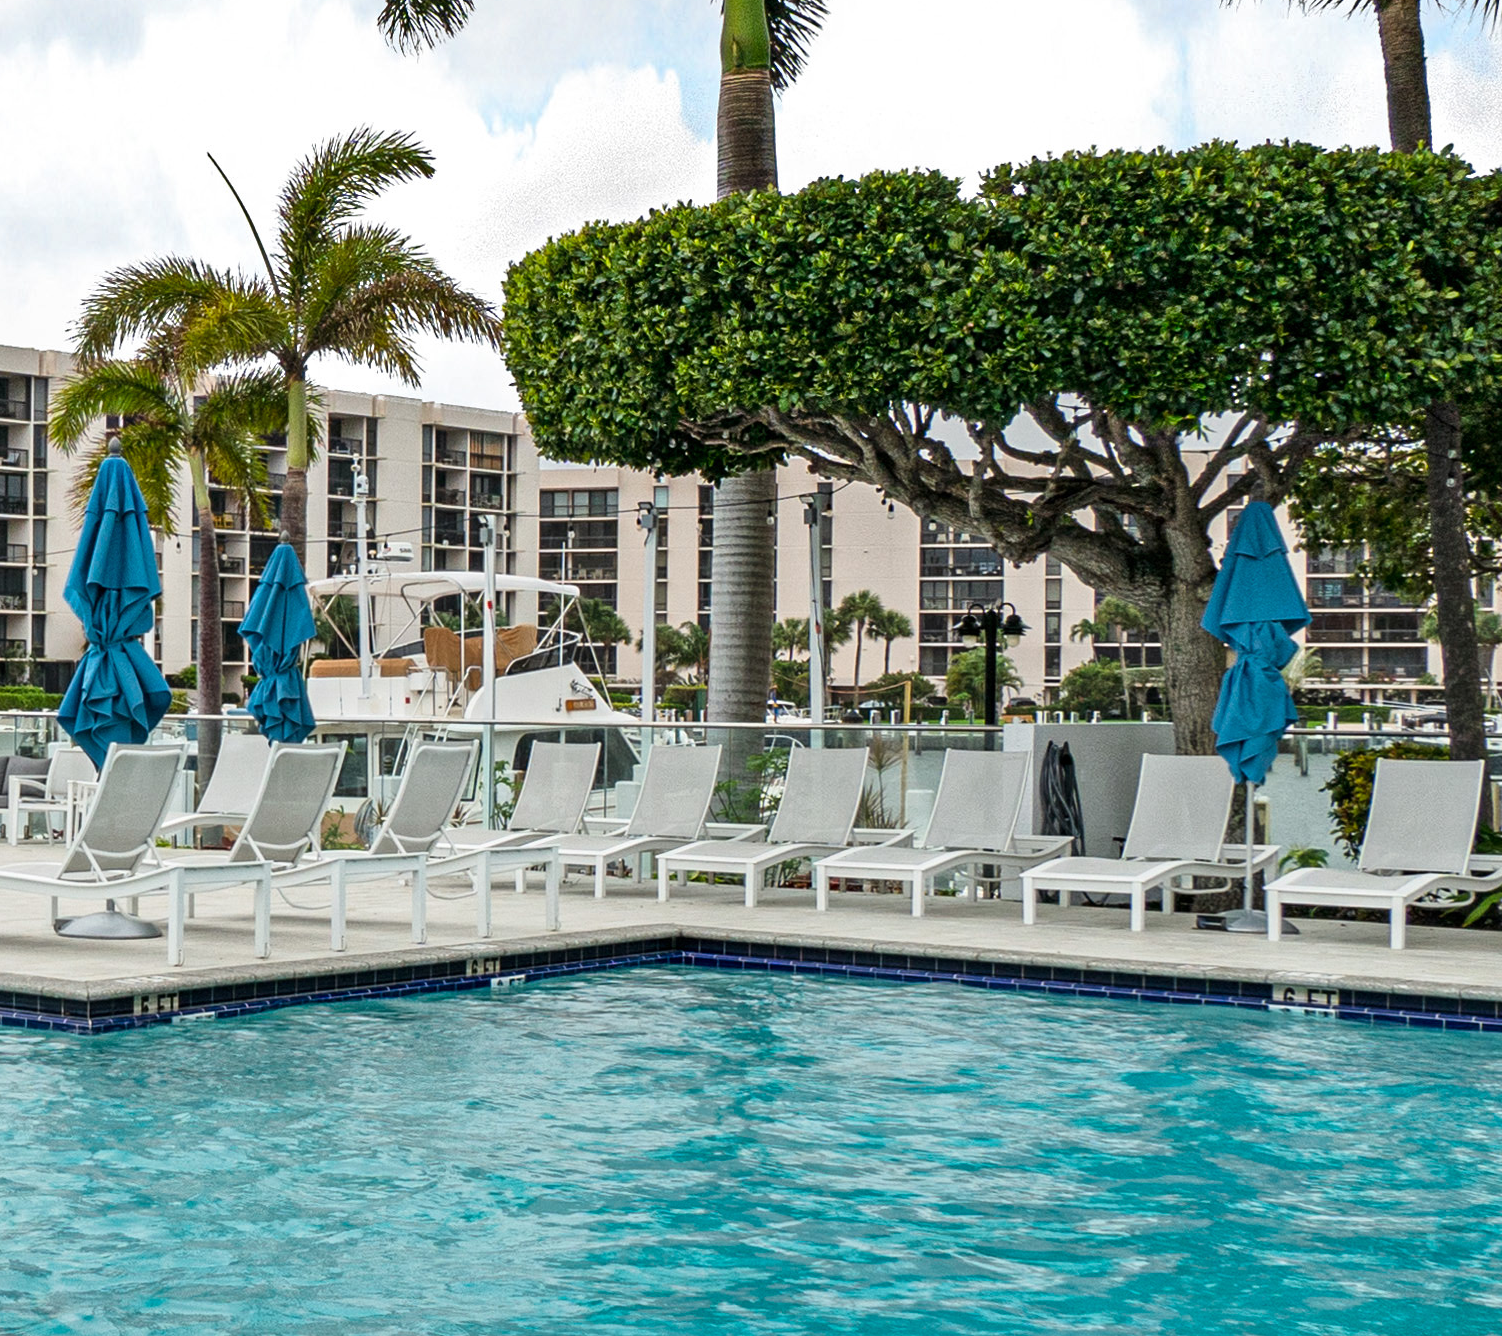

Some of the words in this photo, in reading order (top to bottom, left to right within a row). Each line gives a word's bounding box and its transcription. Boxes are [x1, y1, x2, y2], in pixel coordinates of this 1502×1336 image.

[483, 957, 499, 974] FT
[158, 992, 177, 1012] FT
[1306, 988, 1337, 1004] FT
